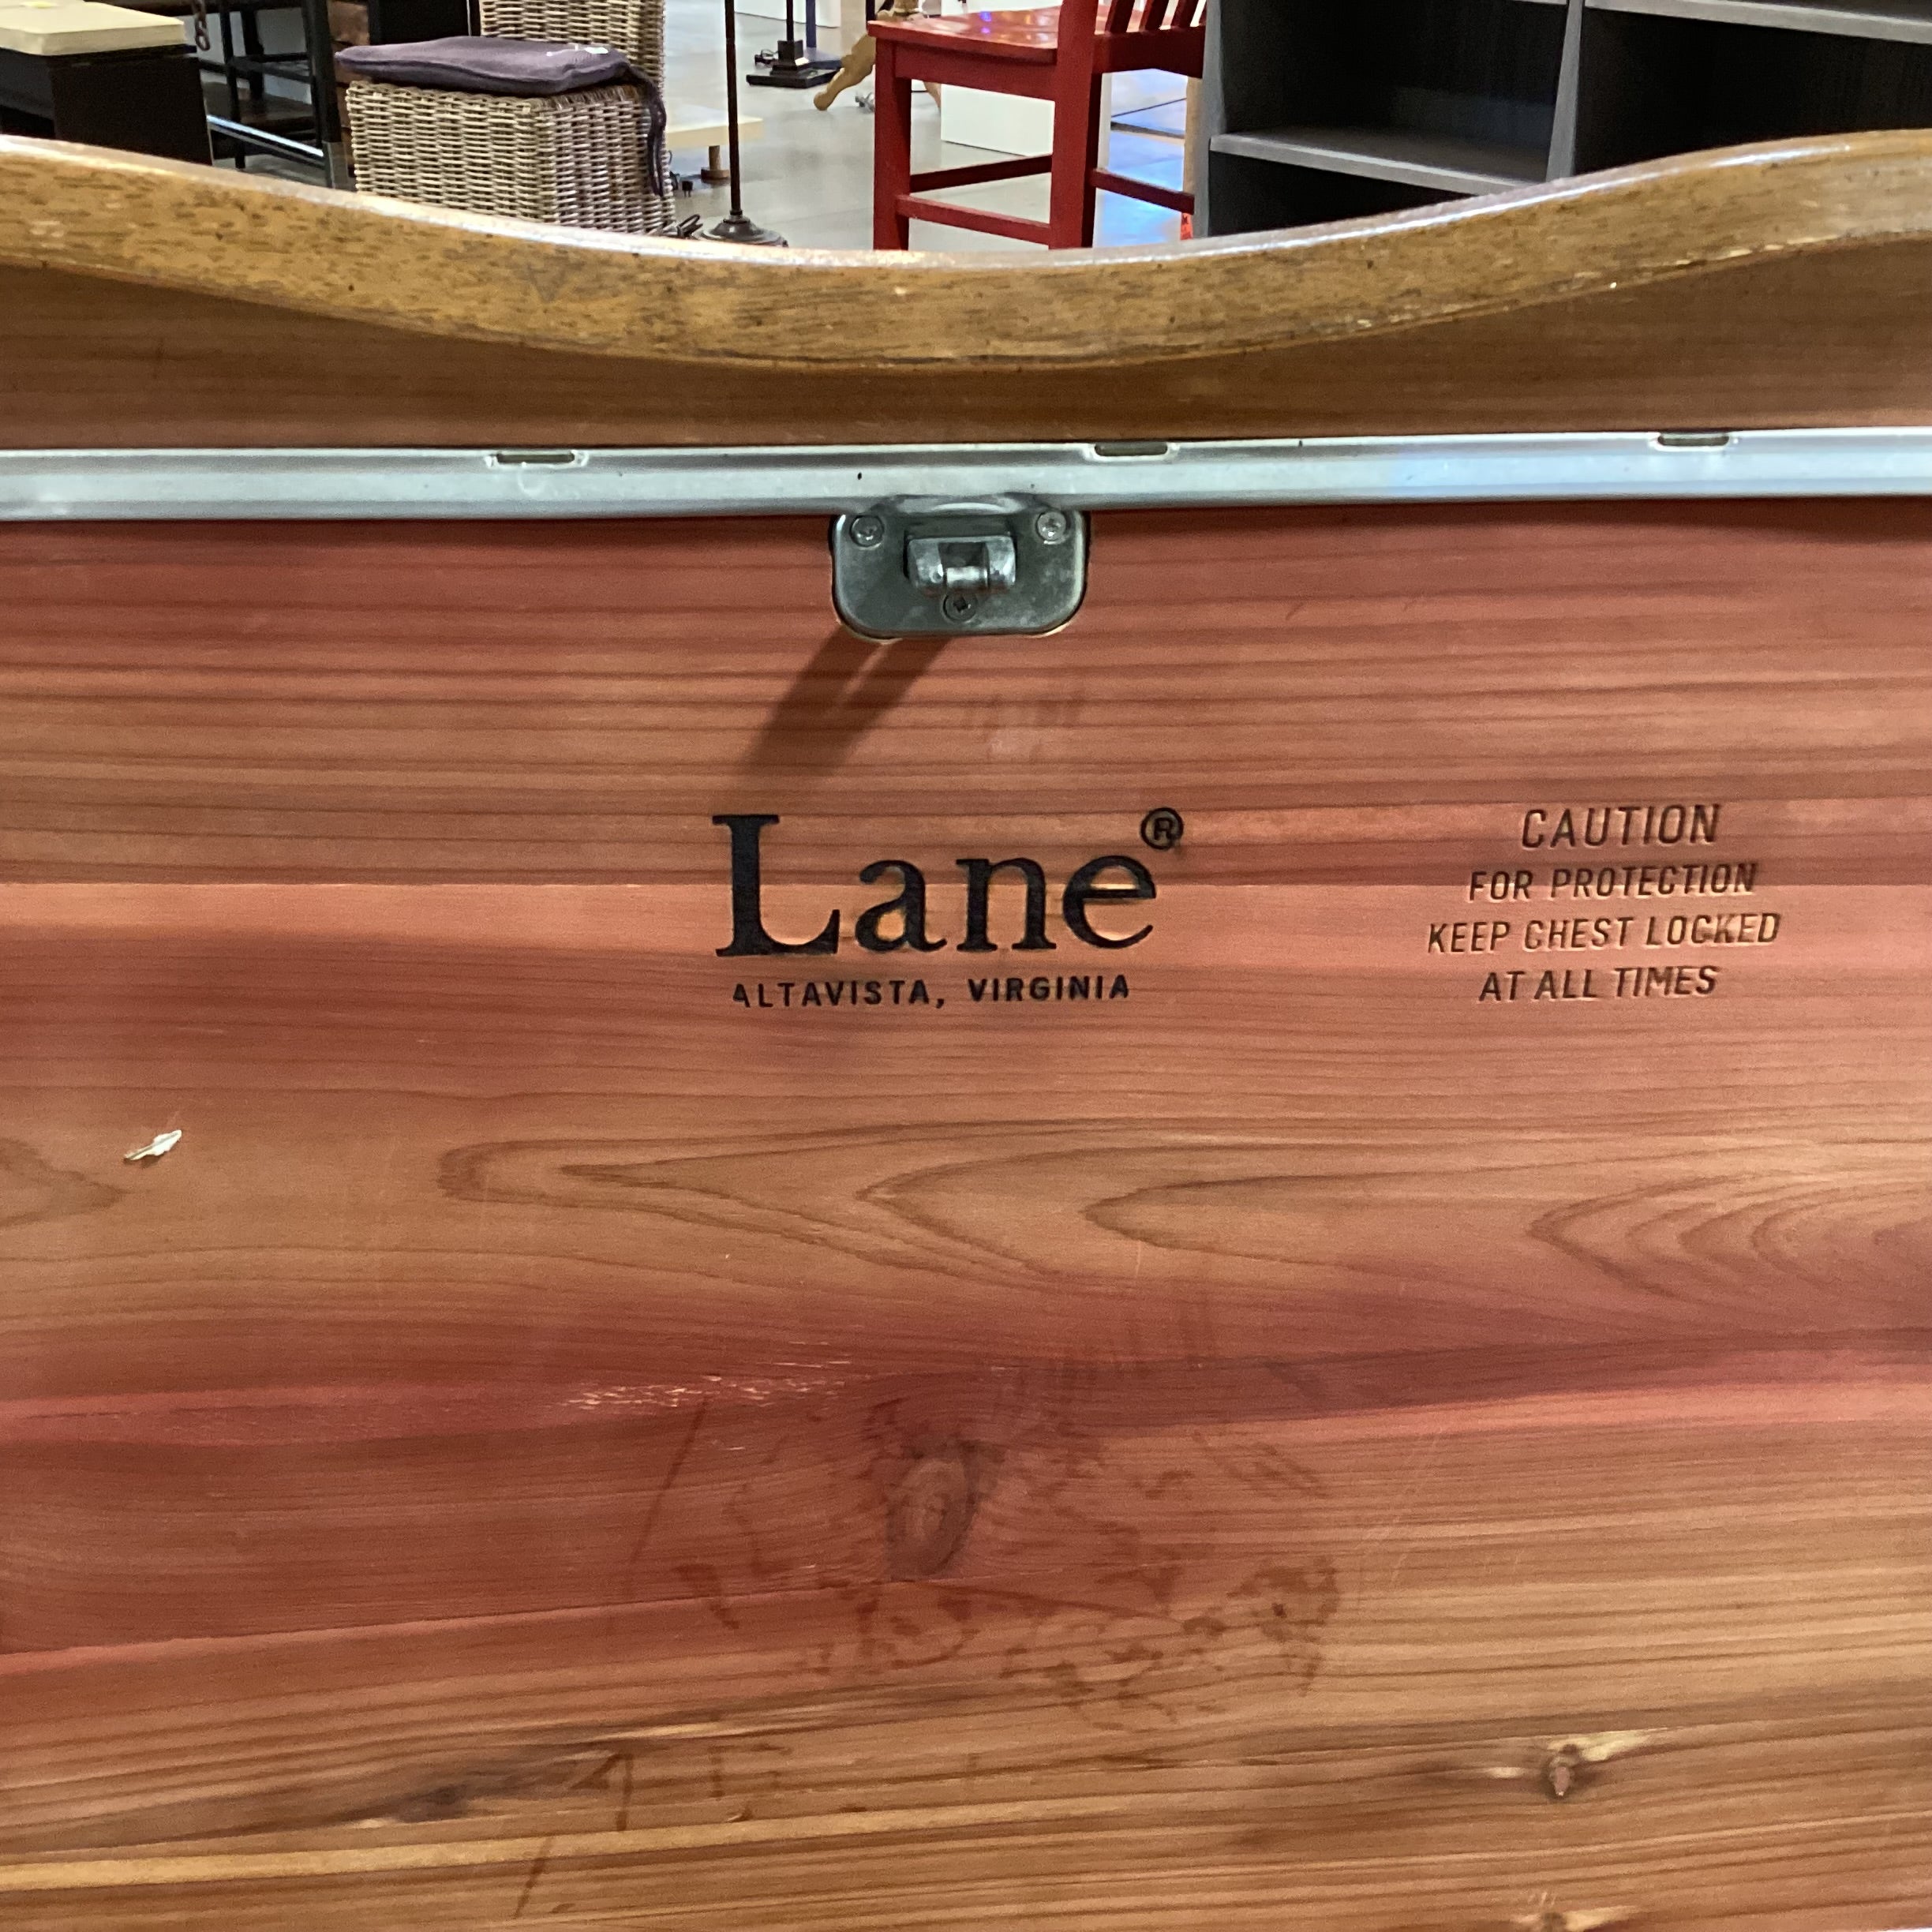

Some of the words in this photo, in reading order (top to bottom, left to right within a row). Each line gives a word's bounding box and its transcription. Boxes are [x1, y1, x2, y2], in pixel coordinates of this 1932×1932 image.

[1522, 803, 1720, 848] CAUTION
[1470, 870, 1533, 901] FOR
[1550, 862, 1758, 899] PROTECTION
[1428, 921, 1511, 953] KEEP
[1524, 915, 1635, 950] CHEST
[1646, 912, 1781, 946] LOCKED
[733, 980, 945, 1009] ALTAVISTA,
[968, 975, 1130, 1002] VIRGINIA
[1478, 970, 1526, 1002] AT
[1533, 968, 1598, 1001] ALL
[1612, 965, 1720, 998] TIMES
